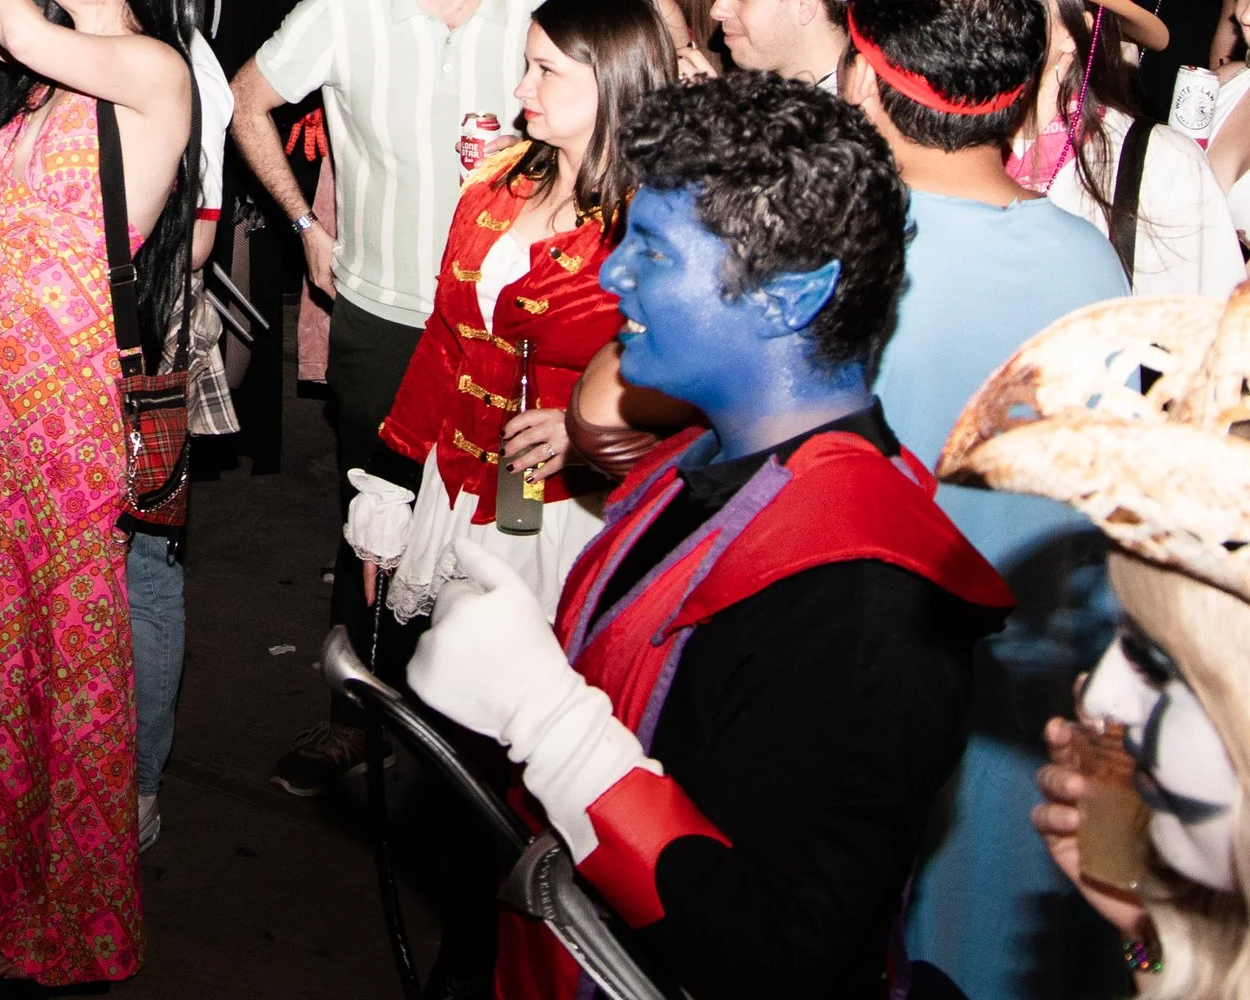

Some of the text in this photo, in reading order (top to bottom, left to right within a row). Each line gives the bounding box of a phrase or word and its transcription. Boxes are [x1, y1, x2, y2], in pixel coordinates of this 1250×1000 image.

[1175, 85, 1192, 110] WHITE
[461, 142, 479, 151] LONE
[461, 149, 479, 158] STAR
